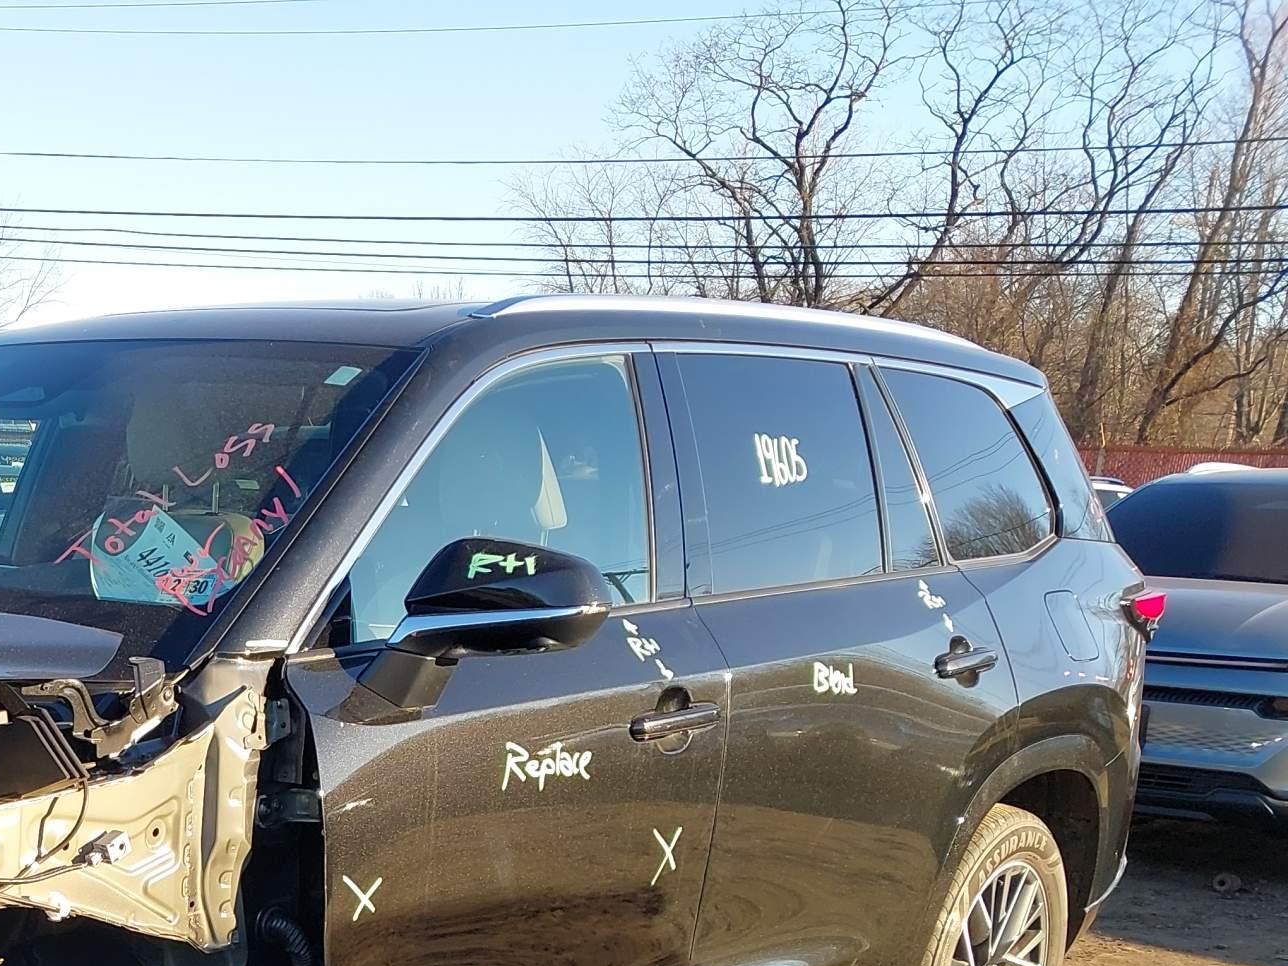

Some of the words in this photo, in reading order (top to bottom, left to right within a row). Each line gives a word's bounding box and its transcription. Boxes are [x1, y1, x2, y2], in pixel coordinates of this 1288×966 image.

[173, 423, 274, 486] Loss
[501, 741, 593, 792] Replace
[978, 831, 1048, 888] ASSURANCE
